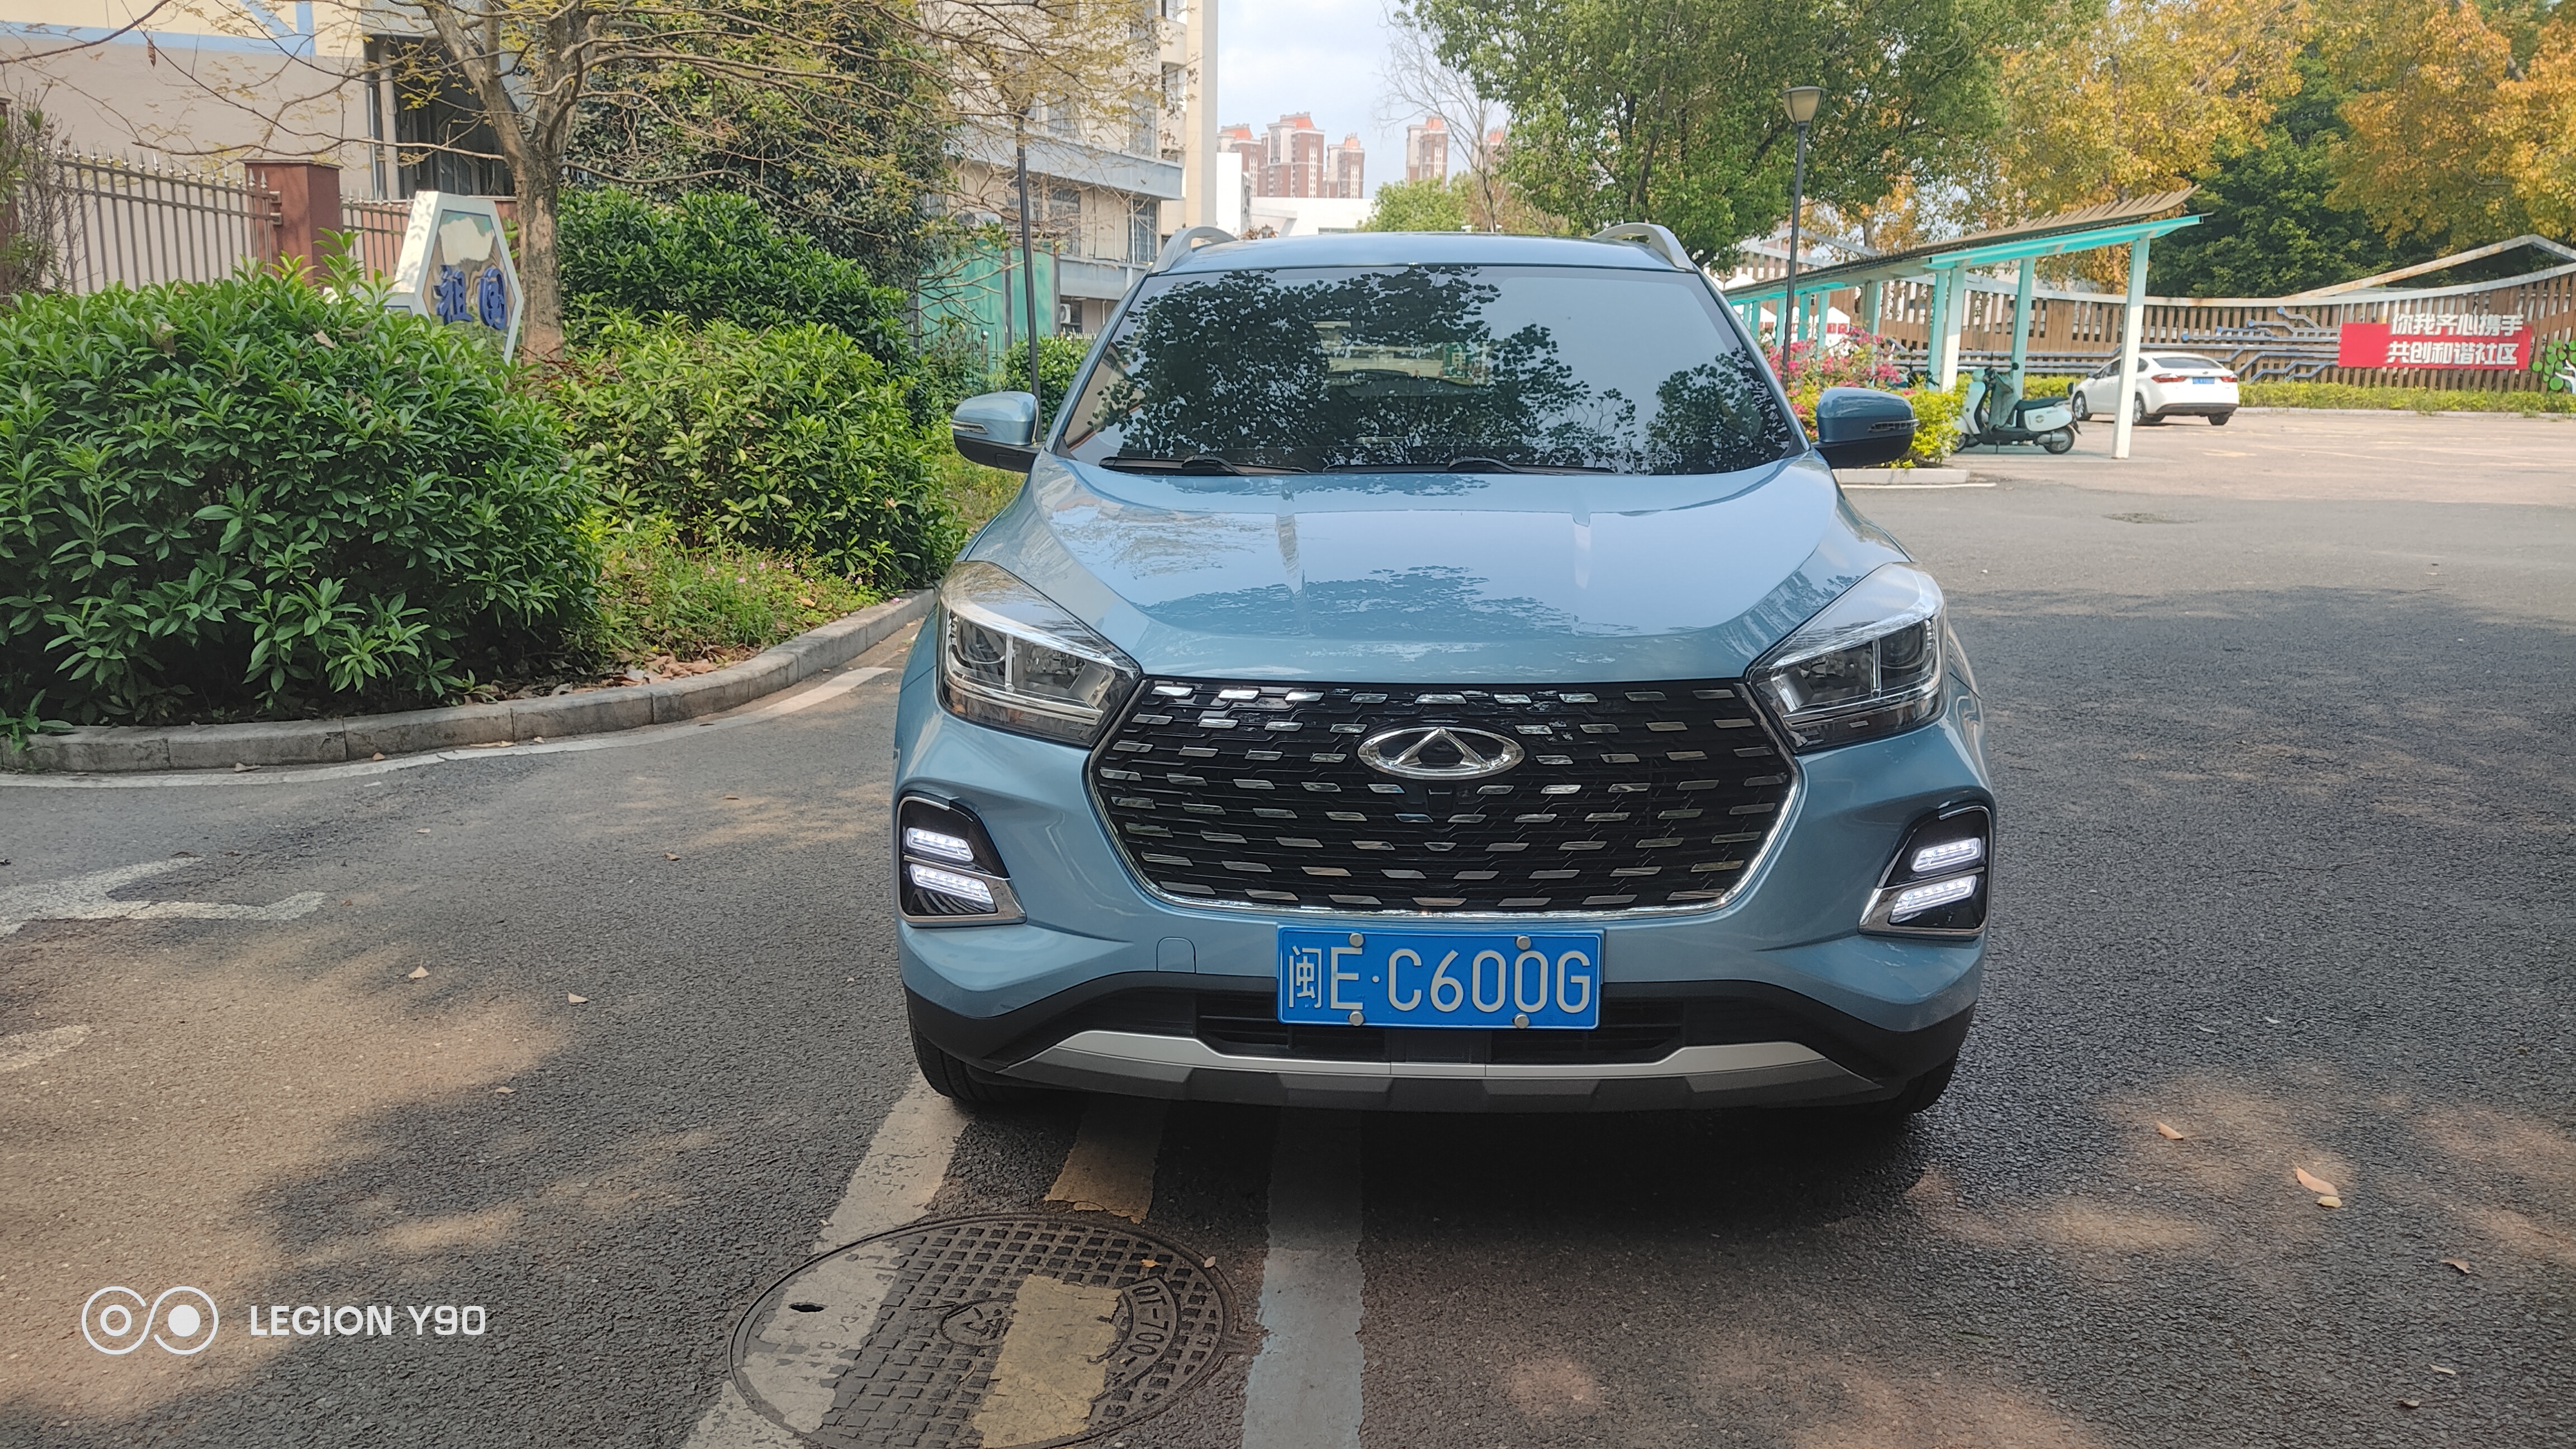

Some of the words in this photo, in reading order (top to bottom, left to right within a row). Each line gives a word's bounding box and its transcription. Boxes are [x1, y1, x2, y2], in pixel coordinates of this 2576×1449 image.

[2392, 313, 2524, 336] 你我齐心携手
[2387, 340, 2519, 364] 共创和谐社区
